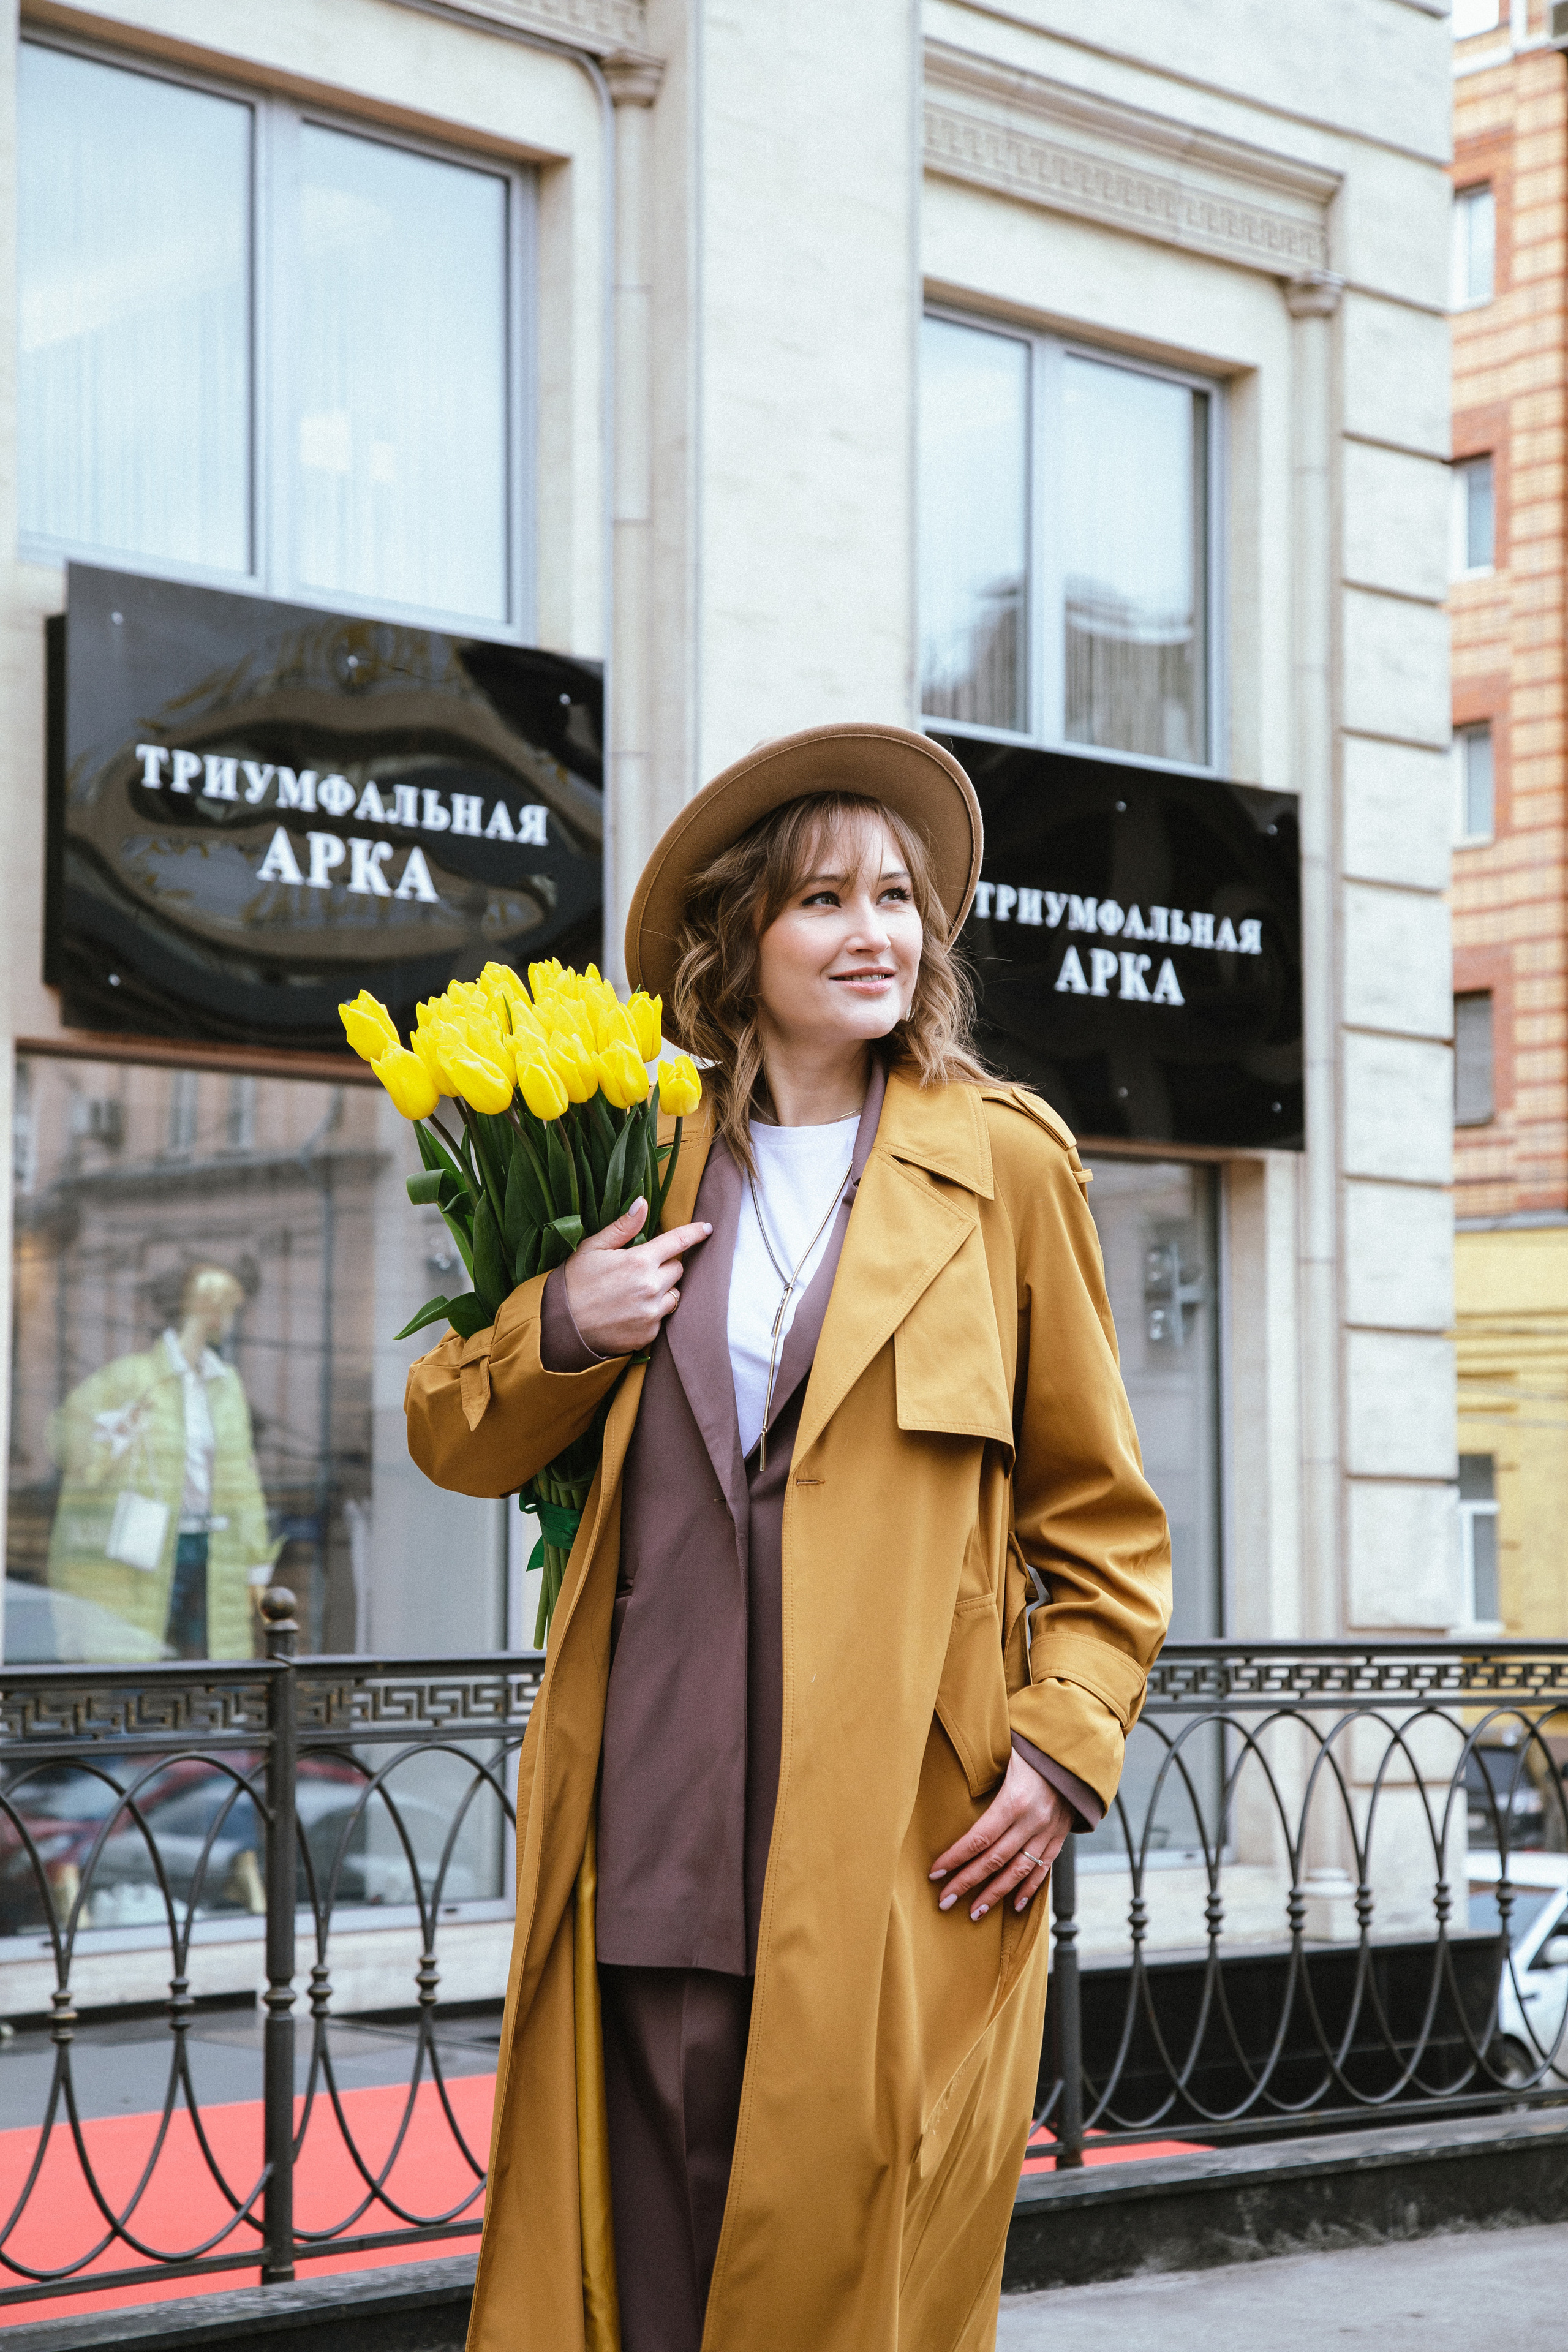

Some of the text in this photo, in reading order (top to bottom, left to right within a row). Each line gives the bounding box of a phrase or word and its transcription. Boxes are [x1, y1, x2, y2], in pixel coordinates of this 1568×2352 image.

[135, 743, 549, 847] ТРИУМФАЛЬНАЯ
[256, 826, 440, 903] АРКА
[975, 881, 1263, 956] ТРИУМФАЛЬНАЯ
[1054, 944, 1185, 1006] АРКА
